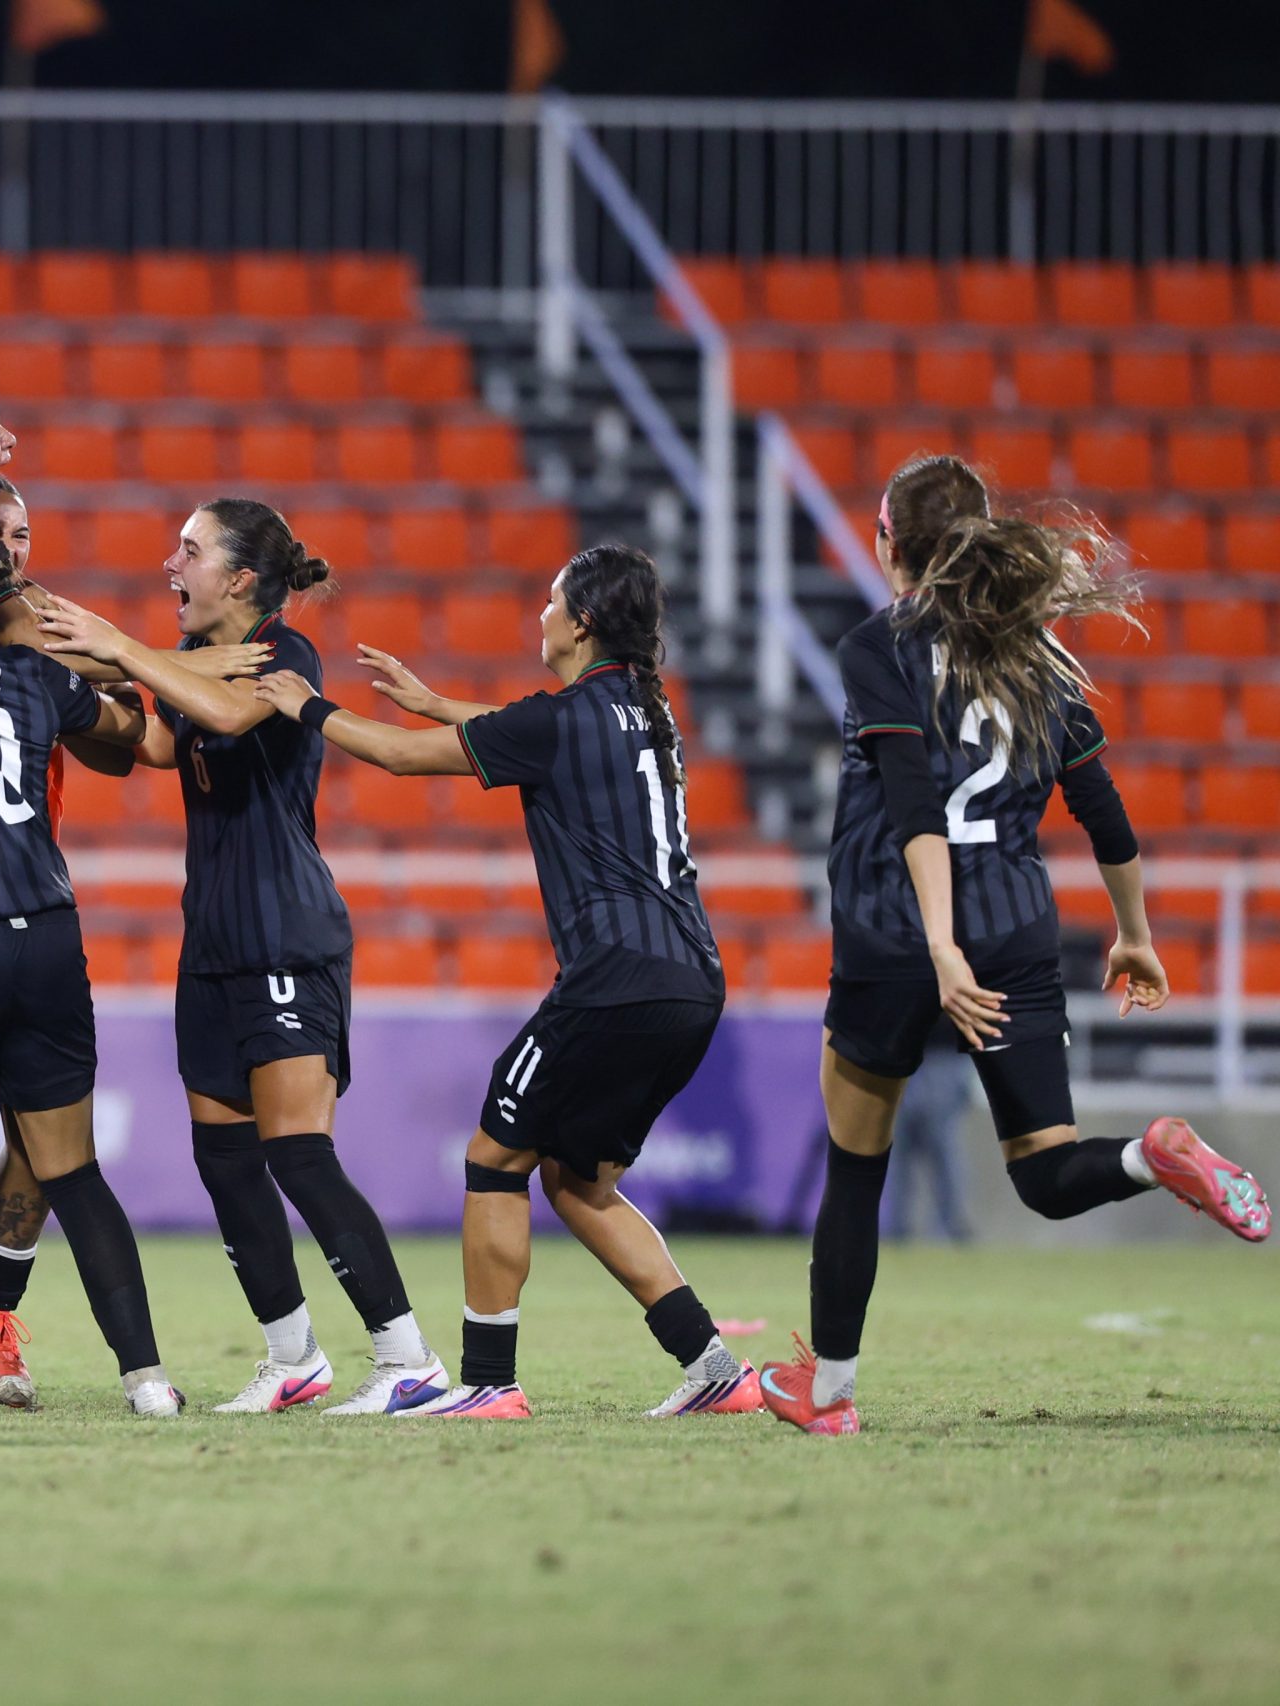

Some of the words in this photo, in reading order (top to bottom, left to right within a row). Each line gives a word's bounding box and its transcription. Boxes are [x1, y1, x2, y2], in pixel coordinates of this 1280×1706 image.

[190, 735, 211, 793] 6
[945, 697, 1013, 844] 2
[506, 1035, 543, 1096] 11
